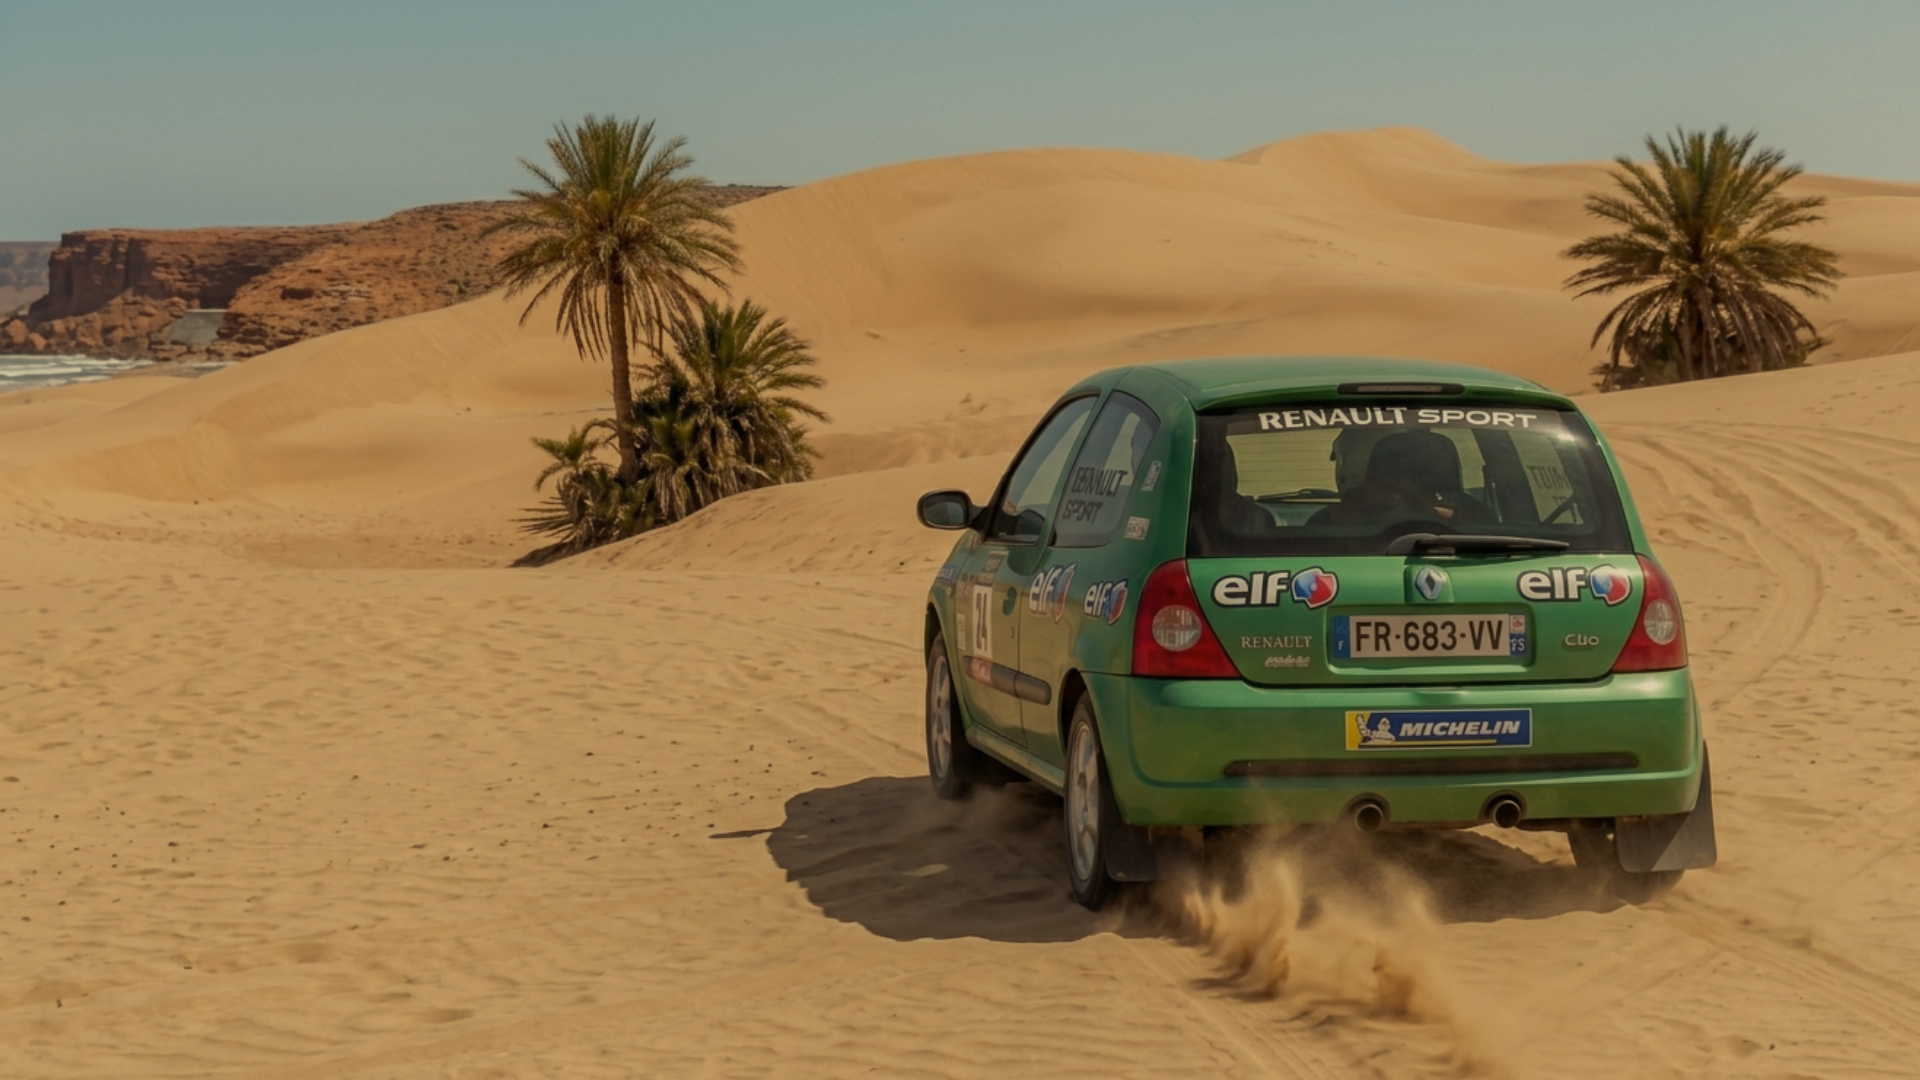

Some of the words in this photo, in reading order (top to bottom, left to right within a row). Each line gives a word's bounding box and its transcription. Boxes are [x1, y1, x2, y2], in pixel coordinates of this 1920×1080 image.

[1258, 407, 1407, 430] RENAULT
[1417, 408, 1537, 428] SPORT
[1029, 566, 1063, 615] elf
[1084, 582, 1113, 616] elf
[1213, 571, 1290, 606] elf
[1518, 568, 1587, 600] elf
[976, 592, 988, 652] 24
[1240, 636, 1313, 649] RENAULT
[1399, 720, 1521, 737] MICHELIN
